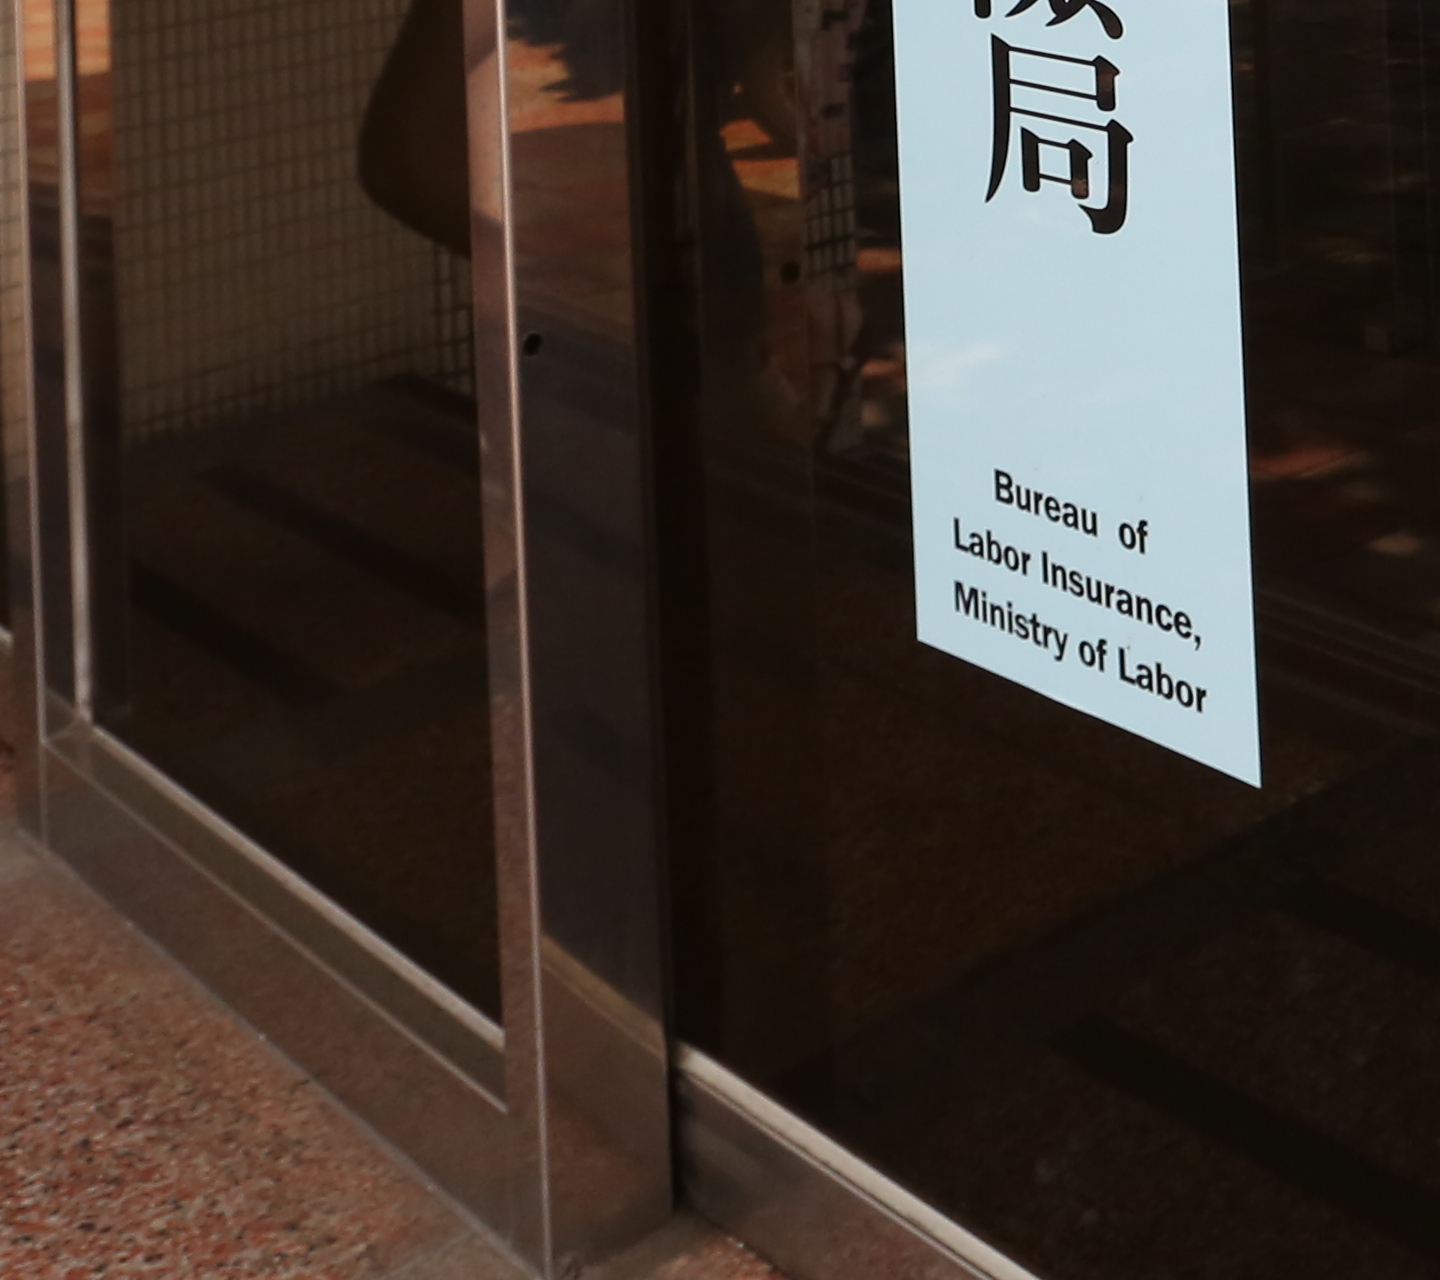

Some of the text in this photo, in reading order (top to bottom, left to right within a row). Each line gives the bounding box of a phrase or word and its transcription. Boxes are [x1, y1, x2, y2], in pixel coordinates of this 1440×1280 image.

[994, 468, 1148, 554] Bureau of
[953, 517, 1202, 651] Labor Insurance,
[954, 580, 1207, 713] Ministry of Labor
